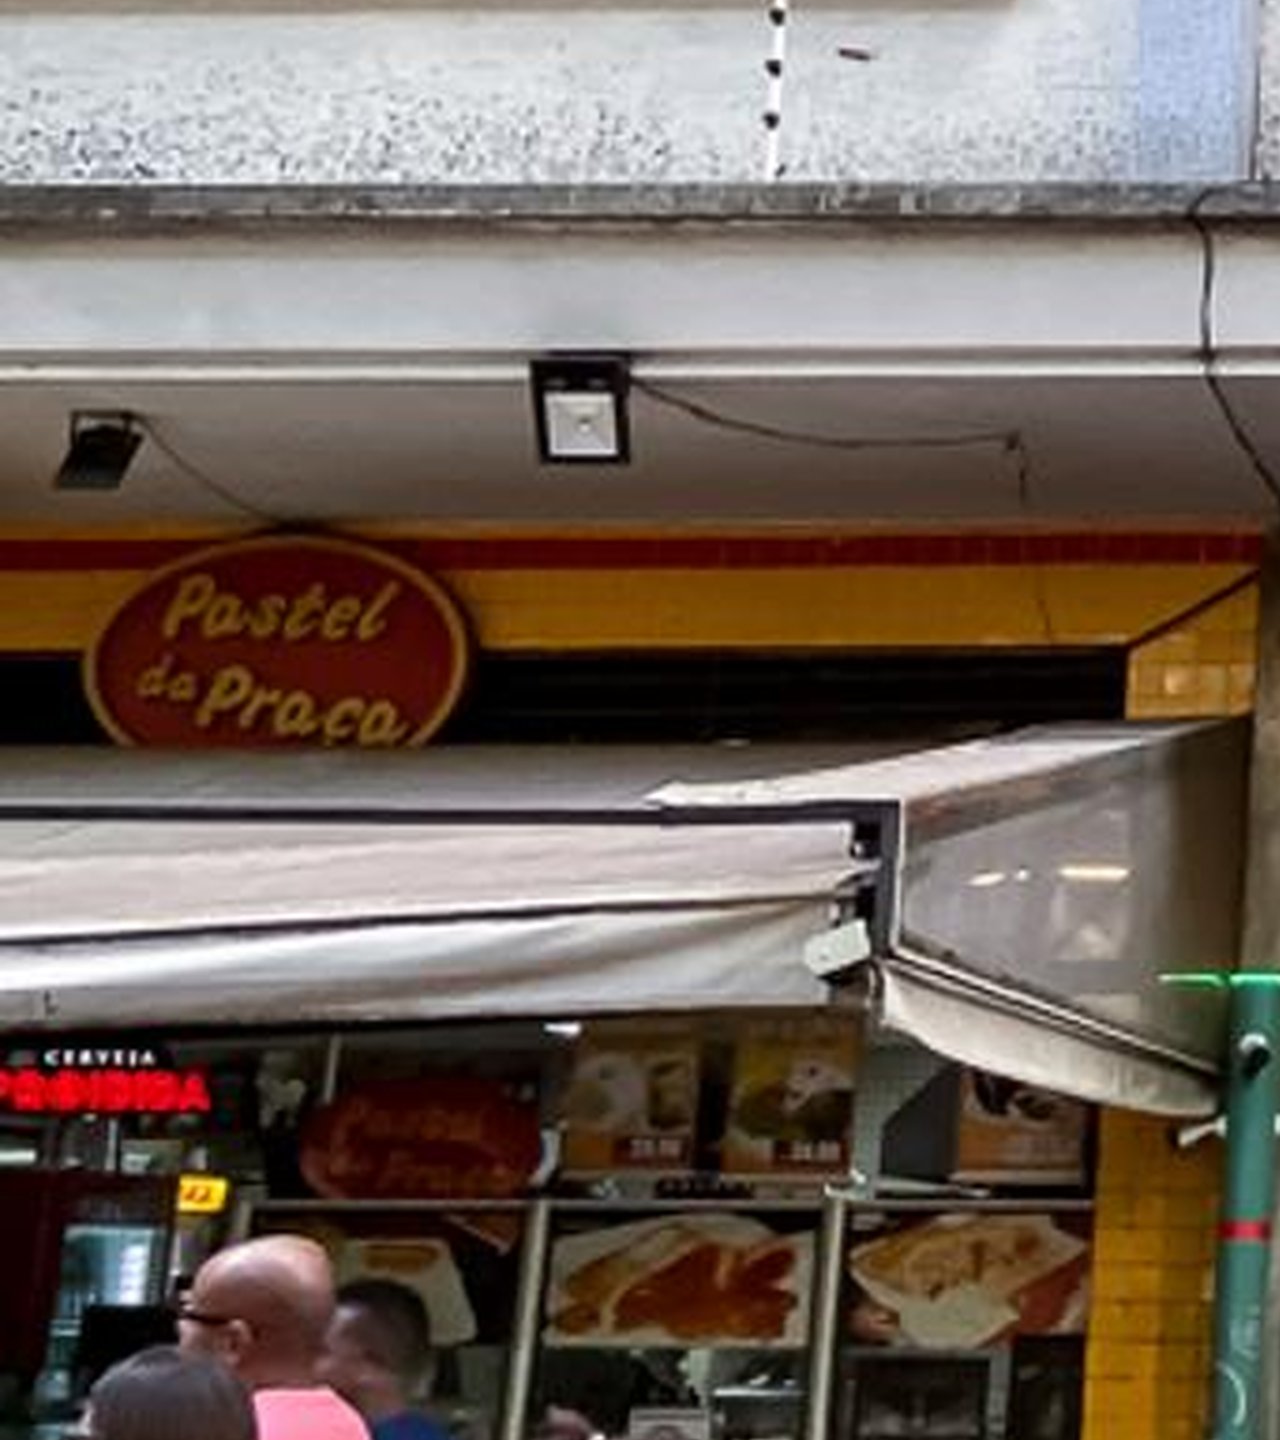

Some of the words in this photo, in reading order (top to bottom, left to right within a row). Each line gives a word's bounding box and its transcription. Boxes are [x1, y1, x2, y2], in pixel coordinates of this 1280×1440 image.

[162, 573, 401, 642] Pastel
[134, 653, 197, 702] da
[197, 664, 408, 747] Praça
[43, 1048, 156, 1067] CERVEJA
